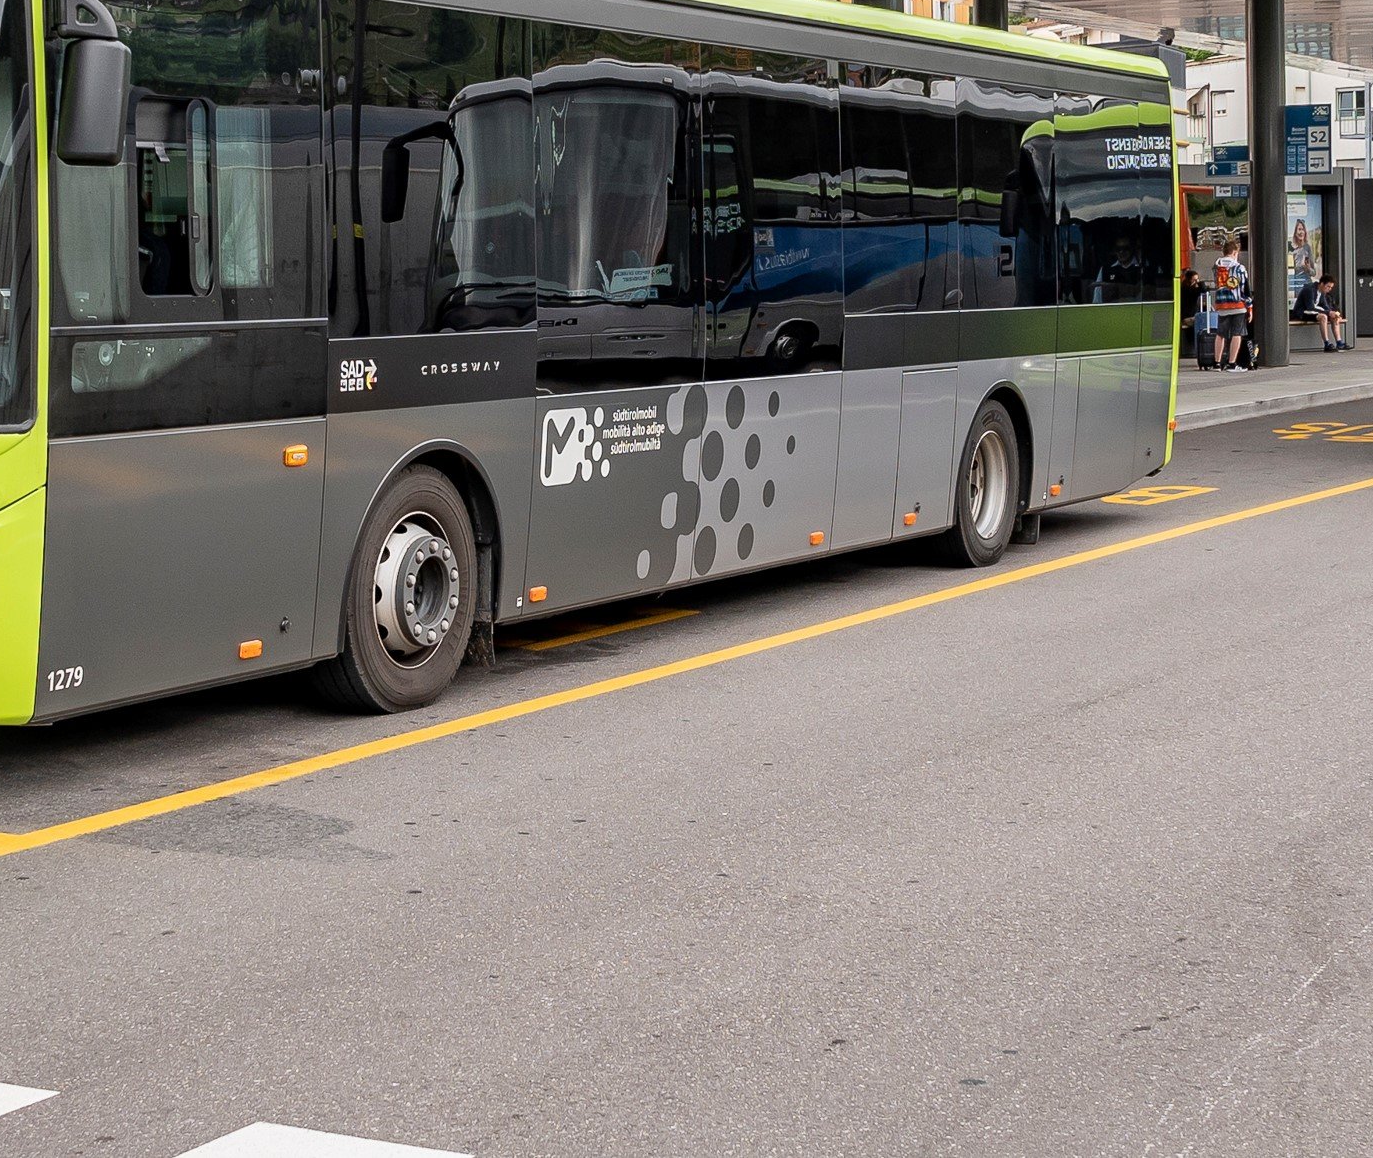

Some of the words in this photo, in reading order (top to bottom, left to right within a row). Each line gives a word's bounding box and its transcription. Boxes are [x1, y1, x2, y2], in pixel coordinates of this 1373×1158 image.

[1311, 131, 1327, 143] S2
[340, 360, 365, 379] SAD
[421, 361, 500, 376] CROSSWAY
[612, 406, 657, 422] südtirolmobil
[602, 425, 631, 439] mobilità
[632, 424, 645, 436] alto
[646, 422, 666, 437] adige
[48, 665, 84, 692] 1279
